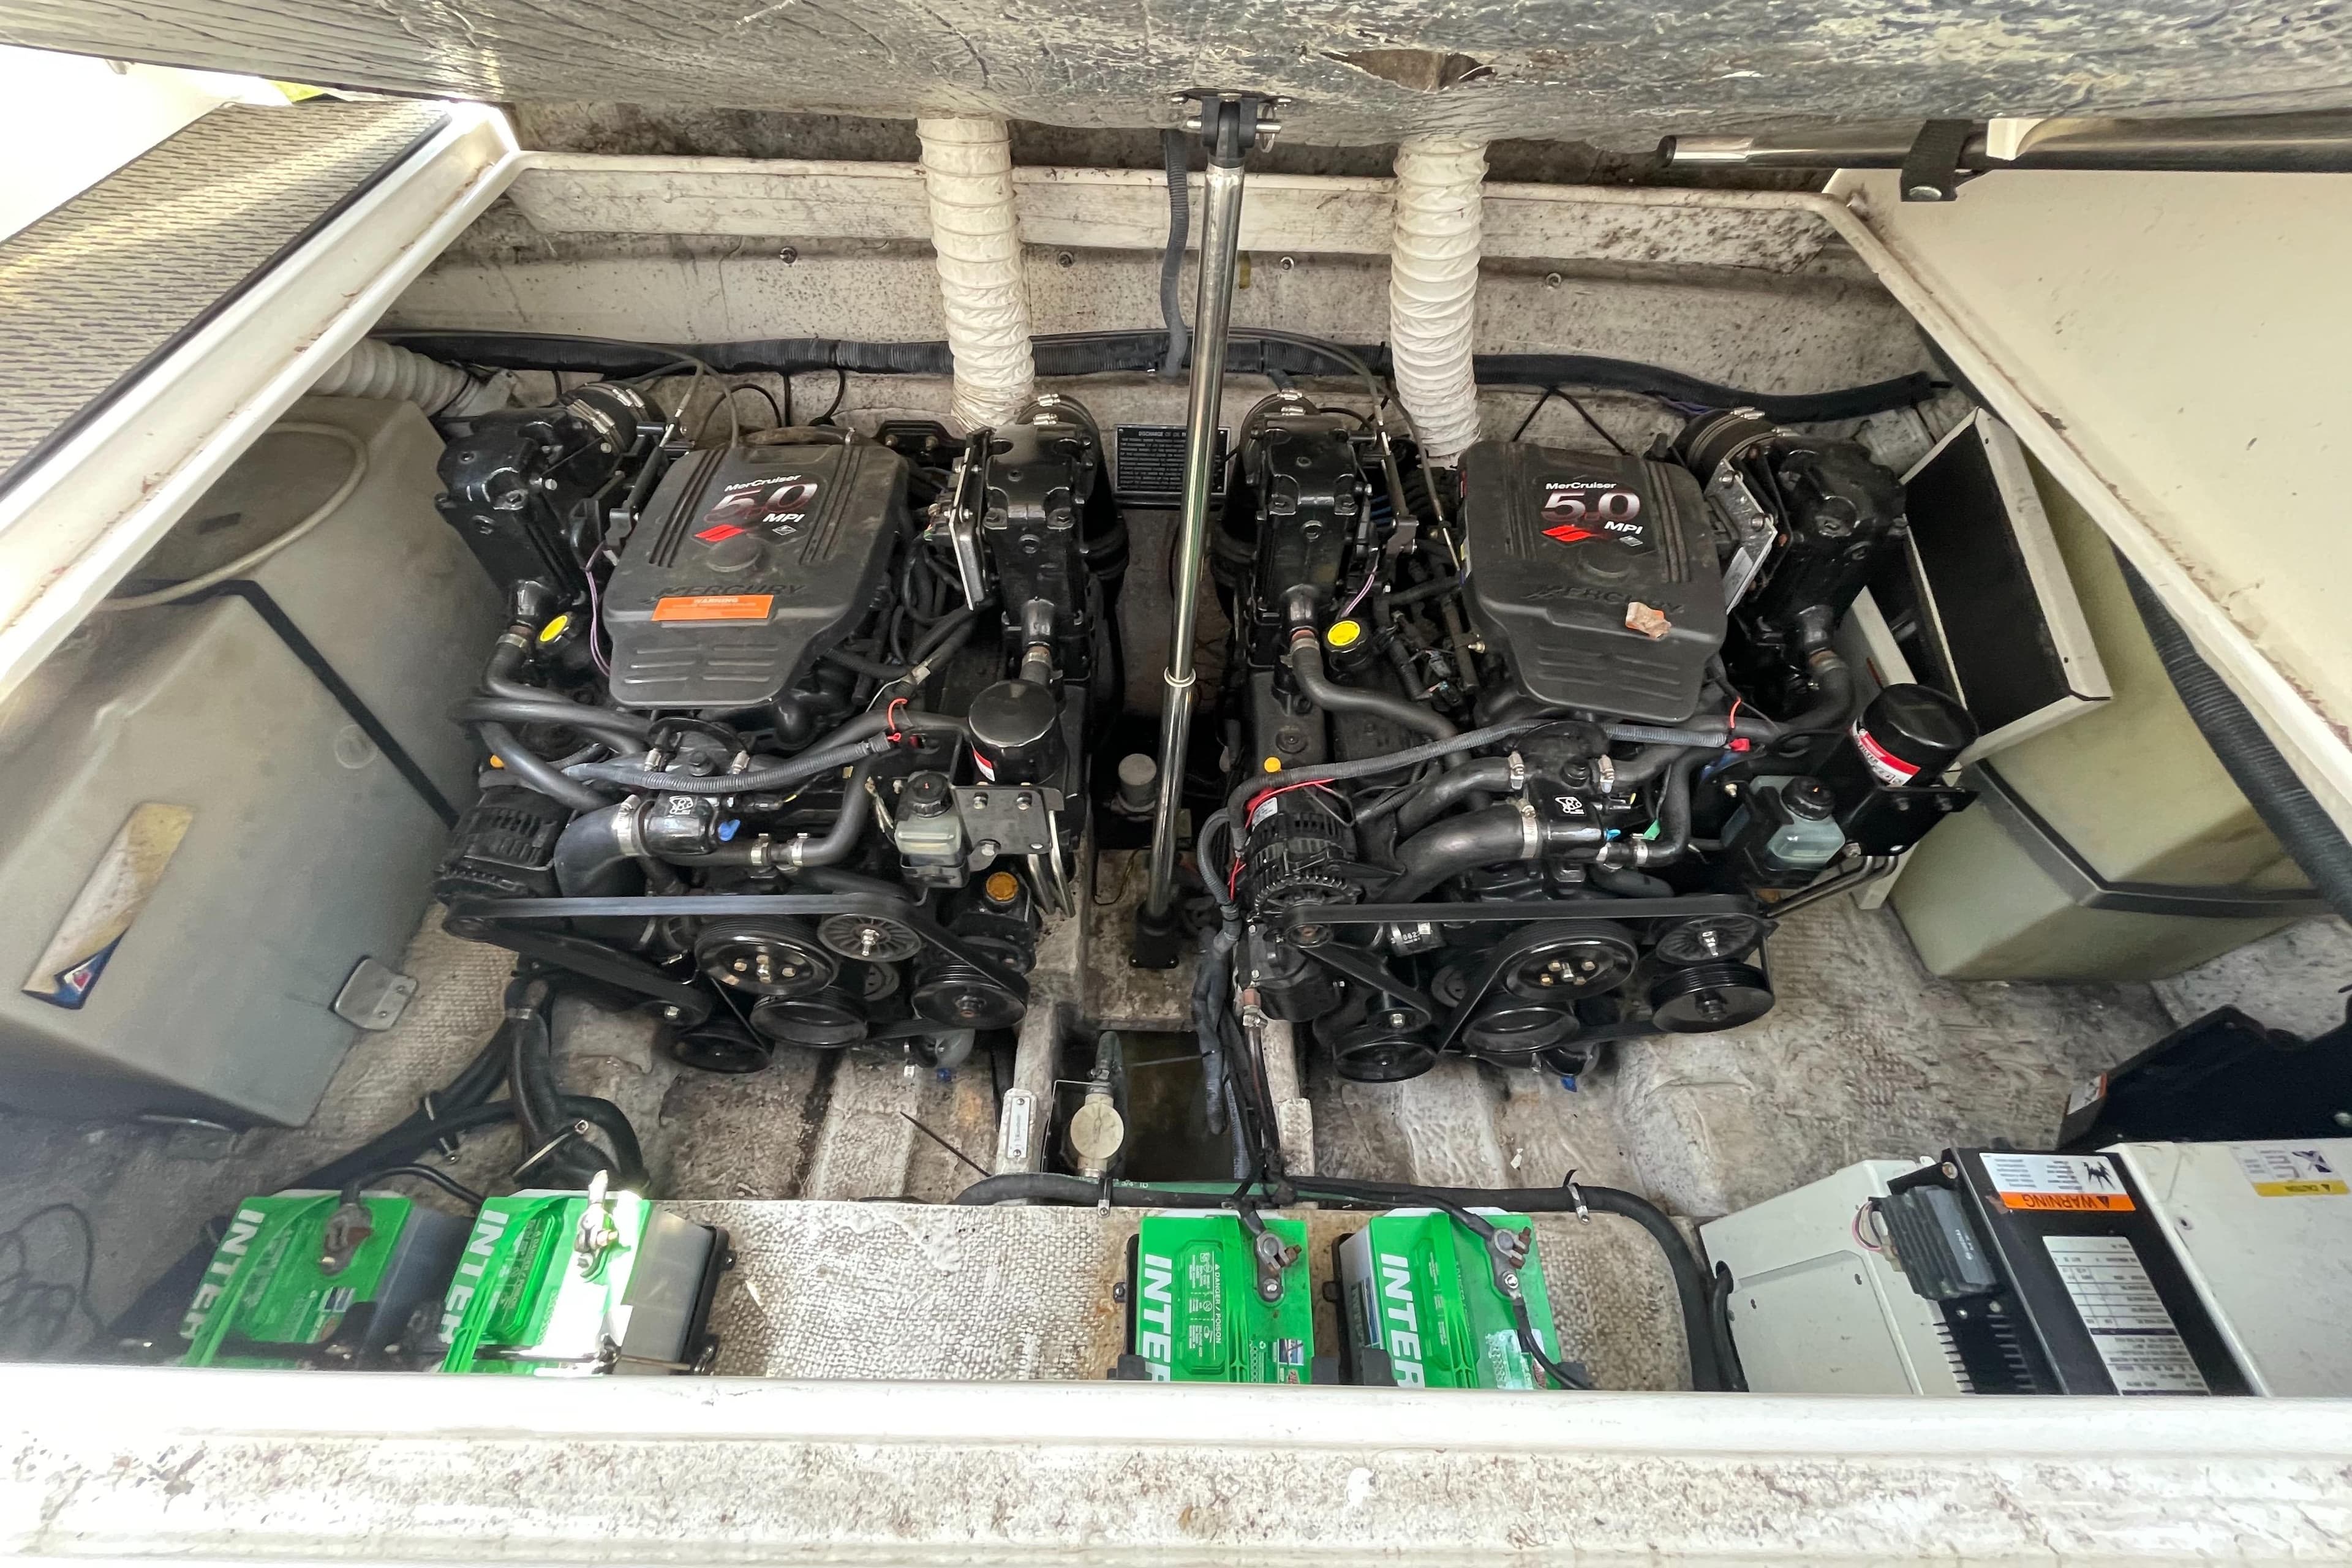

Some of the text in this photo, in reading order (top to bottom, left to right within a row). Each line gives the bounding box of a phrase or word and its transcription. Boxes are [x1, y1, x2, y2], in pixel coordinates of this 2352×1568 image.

[725, 475, 801, 492] MerCruiser
[1540, 489, 1641, 522] 5.0
[763, 513, 805, 522] MPI
[1604, 521, 1643, 534] MPI
[2022, 1194, 2097, 1208] WARNING
